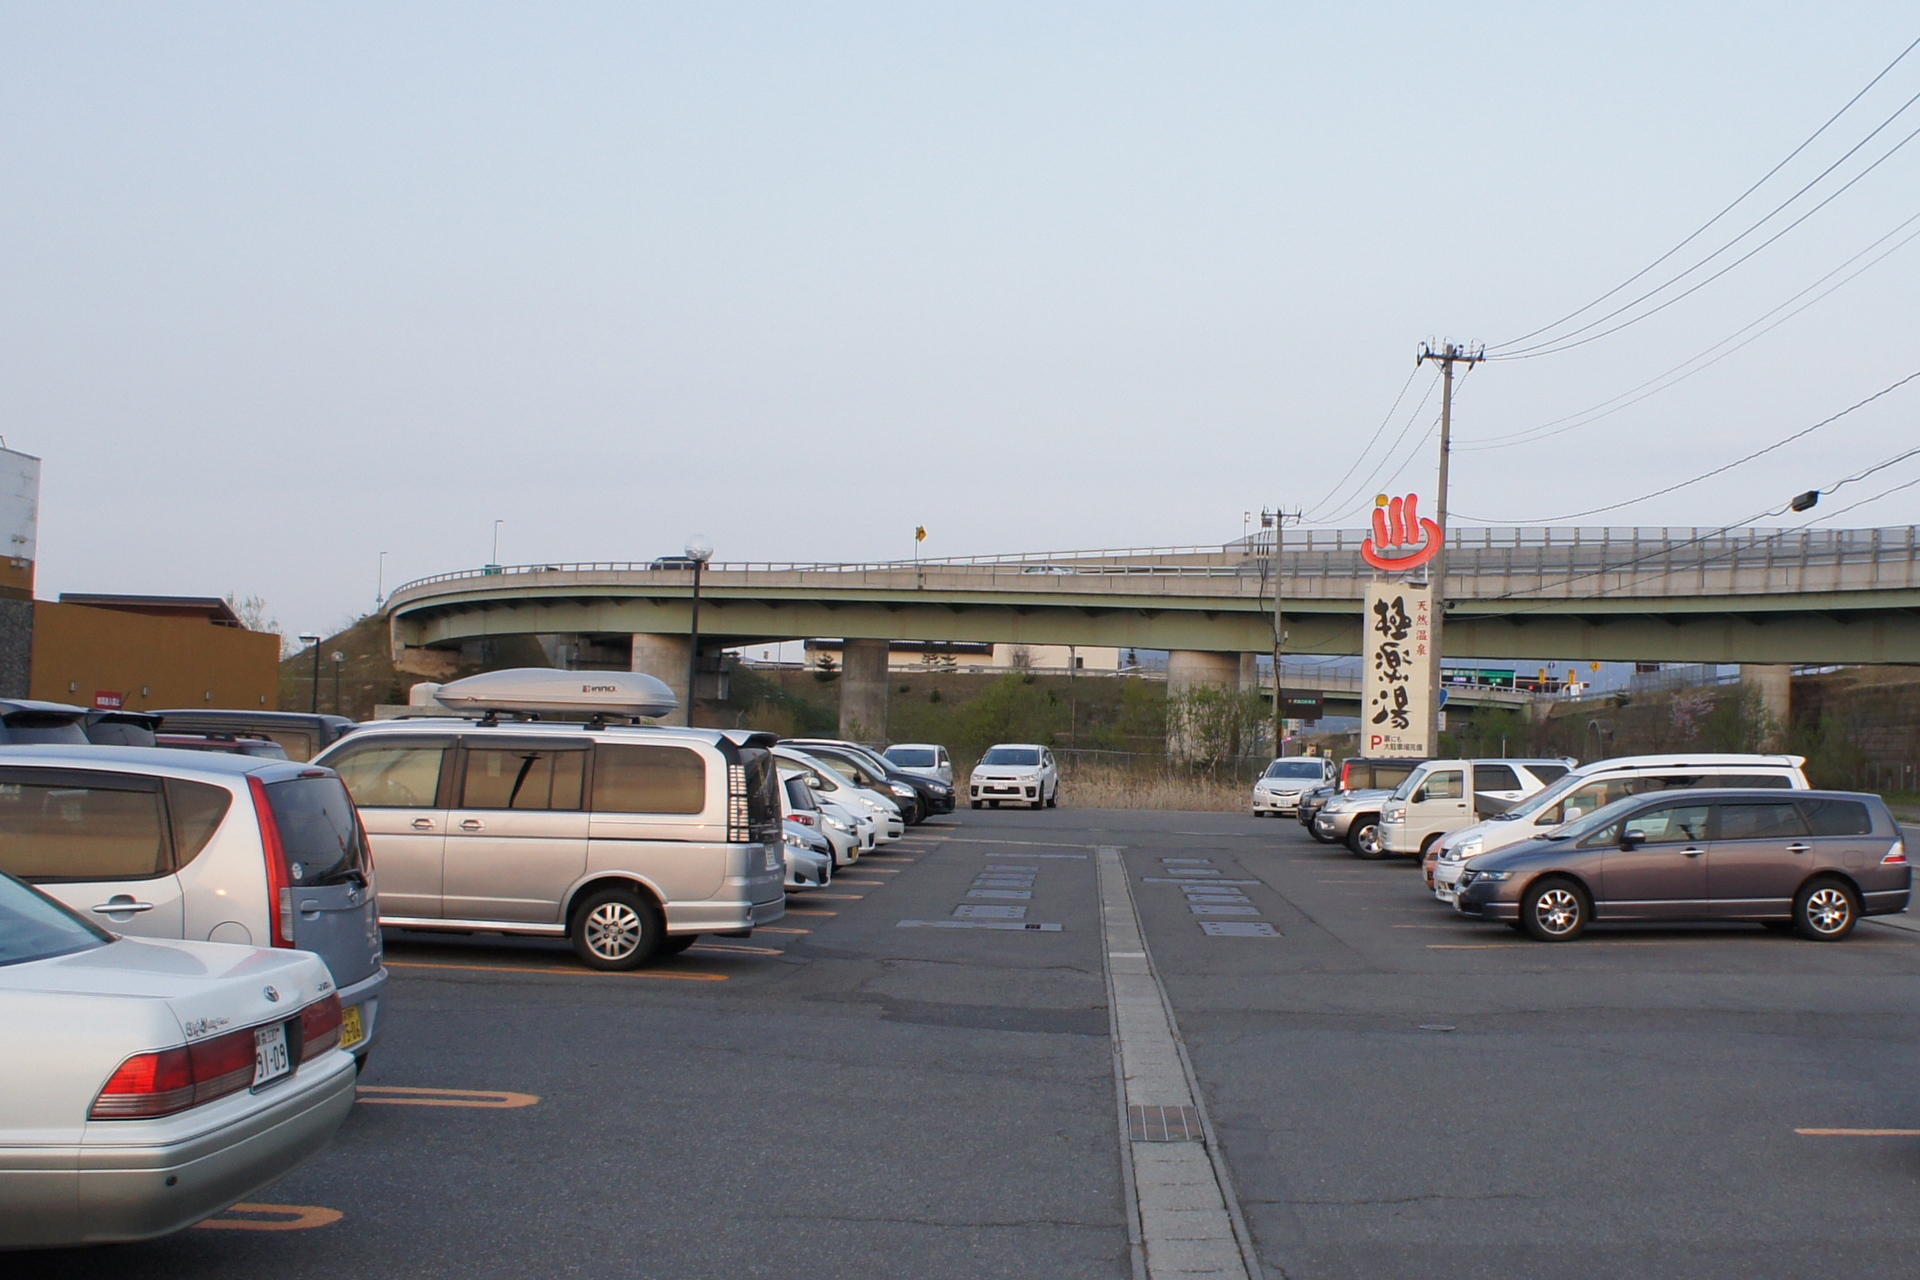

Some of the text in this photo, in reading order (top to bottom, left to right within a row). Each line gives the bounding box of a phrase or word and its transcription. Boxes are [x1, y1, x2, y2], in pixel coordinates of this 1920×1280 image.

[1416, 600, 1428, 656] 天然温泉
[1372, 596, 1413, 730] 極楽湯
[1371, 735, 1383, 750] P
[257, 1043, 287, 1078] 91-09
